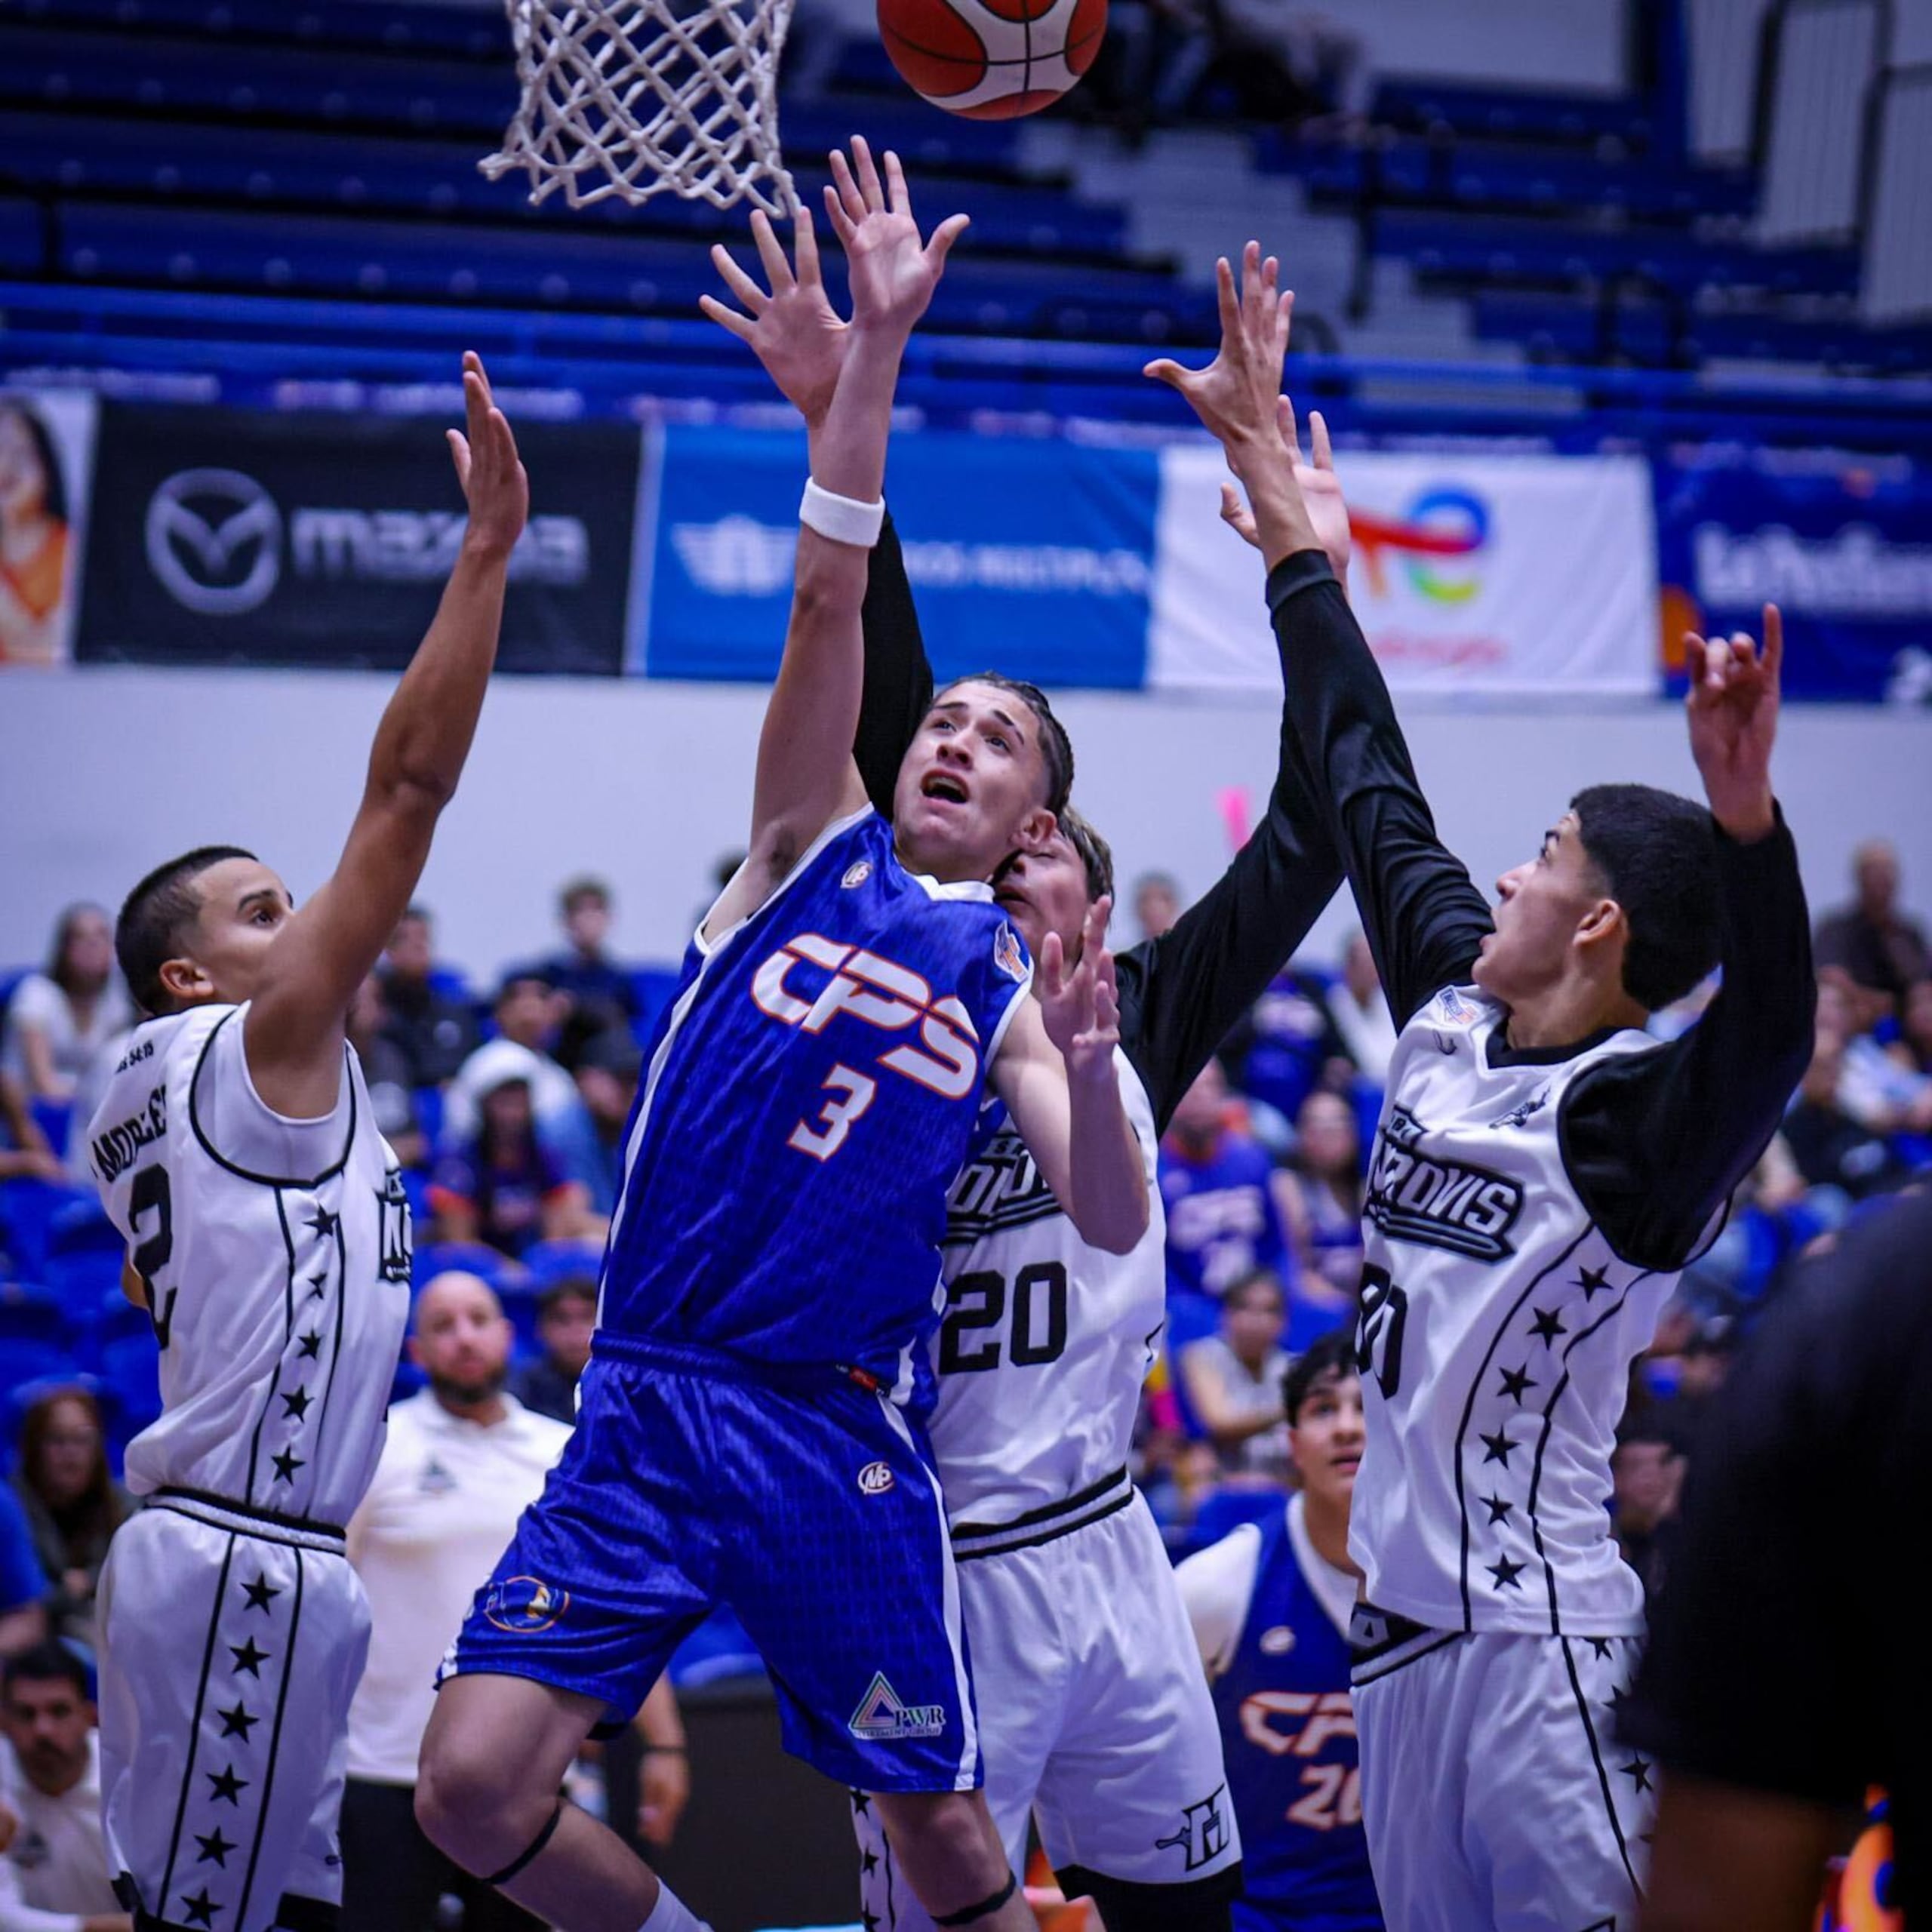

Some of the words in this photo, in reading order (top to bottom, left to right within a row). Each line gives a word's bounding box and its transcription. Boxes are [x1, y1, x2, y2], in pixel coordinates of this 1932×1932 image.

[292, 508, 589, 585] maza
[751, 933, 982, 1100] CPS
[786, 1063, 877, 1162] 3
[128, 1163, 178, 1351] 2
[939, 1261, 1067, 1375] 20
[894, 1706, 944, 1727] PWR
[1239, 1690, 1358, 1757] CP
